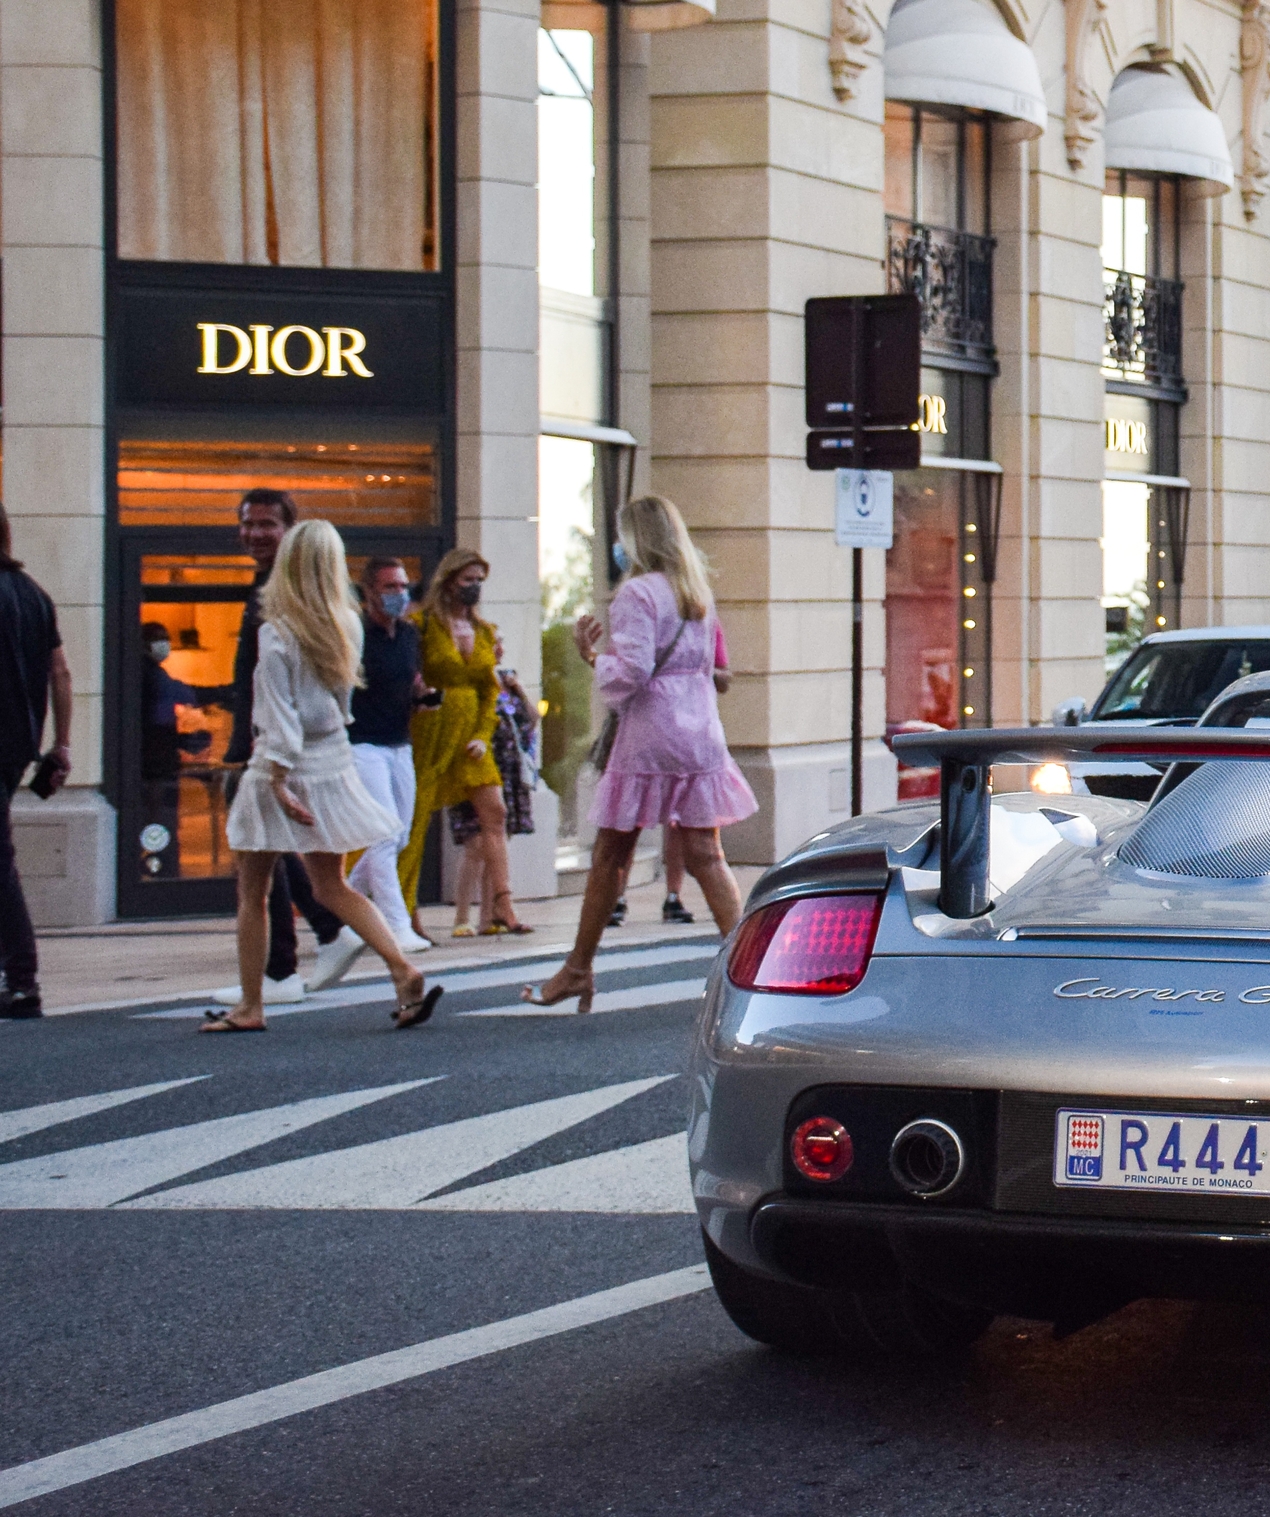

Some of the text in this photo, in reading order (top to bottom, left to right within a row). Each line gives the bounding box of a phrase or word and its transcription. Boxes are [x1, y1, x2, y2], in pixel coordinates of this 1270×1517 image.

[197, 323, 375, 378] DIOR
[911, 394, 948, 434] OR
[1106, 418, 1148, 454] DIOR
[1053, 977, 1226, 1002] Carrera
[1119, 1119, 1263, 1176] R444
[1073, 1158, 1094, 1175] MC
[1124, 1174, 1253, 1189] PRINCIPAUTE DE MONACO
